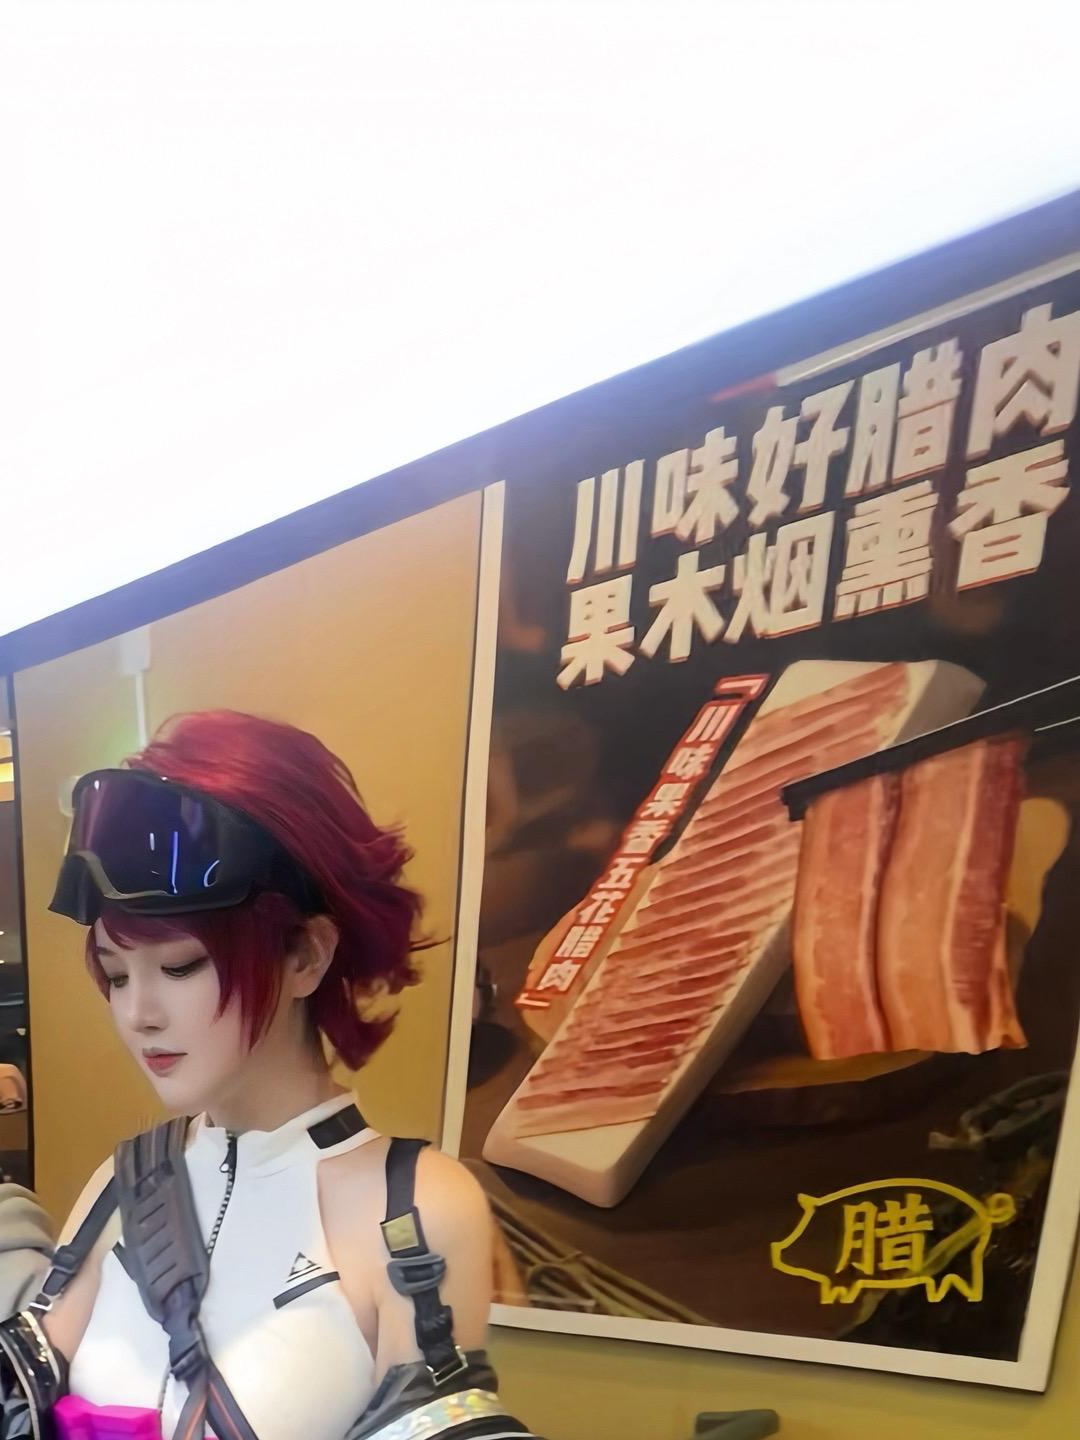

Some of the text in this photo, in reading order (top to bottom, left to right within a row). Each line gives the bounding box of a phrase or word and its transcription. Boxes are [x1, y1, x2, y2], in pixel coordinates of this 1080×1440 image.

[556, 439, 1070, 690] 果木烟熏香
[566, 303, 1080, 584] 川味好腊肉
[836, 1193, 934, 1275] 腊
